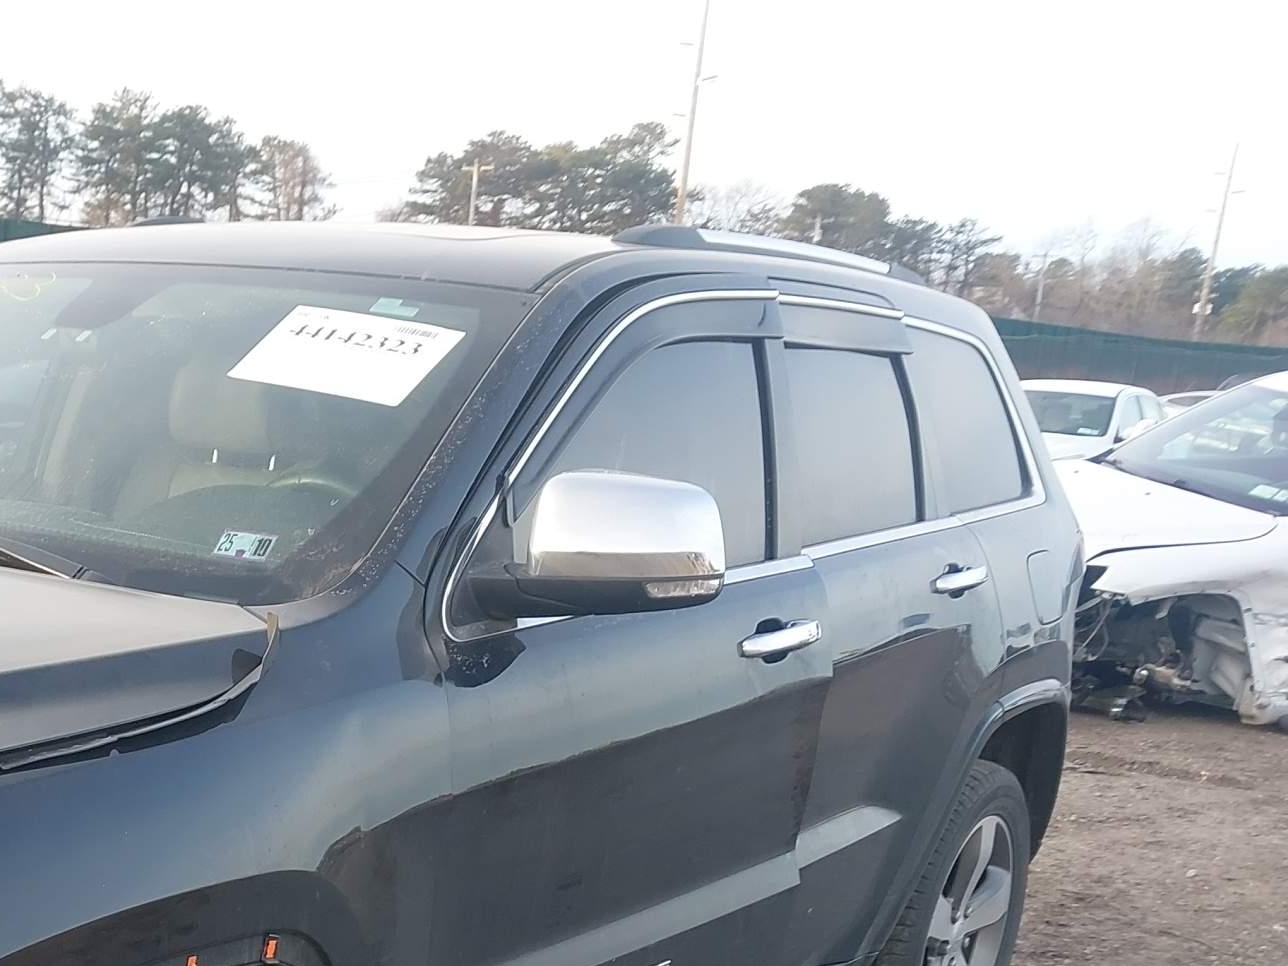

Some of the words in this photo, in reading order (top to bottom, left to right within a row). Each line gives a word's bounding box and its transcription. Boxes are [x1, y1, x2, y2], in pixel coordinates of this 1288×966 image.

[290, 324, 423, 354] 44142323
[217, 533, 238, 551] 25
[253, 538, 273, 556] 10
